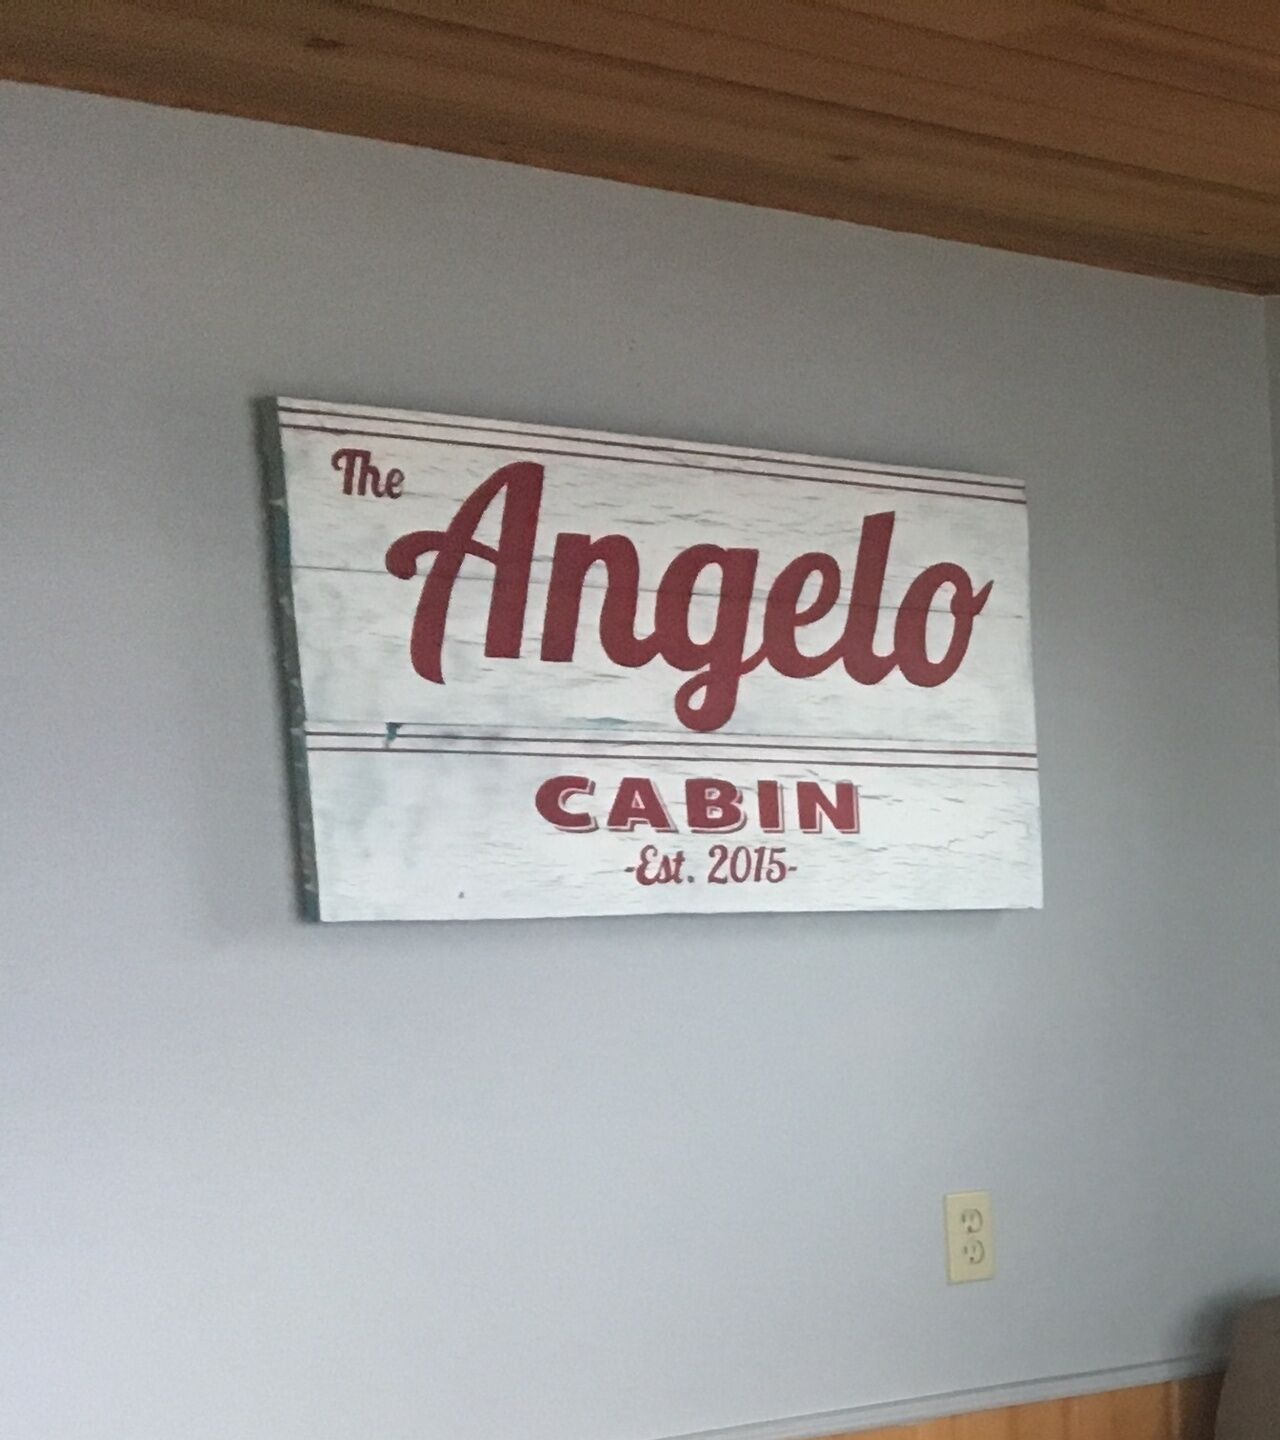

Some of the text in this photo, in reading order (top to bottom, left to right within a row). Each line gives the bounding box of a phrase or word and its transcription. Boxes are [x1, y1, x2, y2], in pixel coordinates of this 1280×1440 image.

[331, 447, 404, 499] The
[385, 461, 993, 732] Angelo
[535, 775, 860, 834] CABIN
